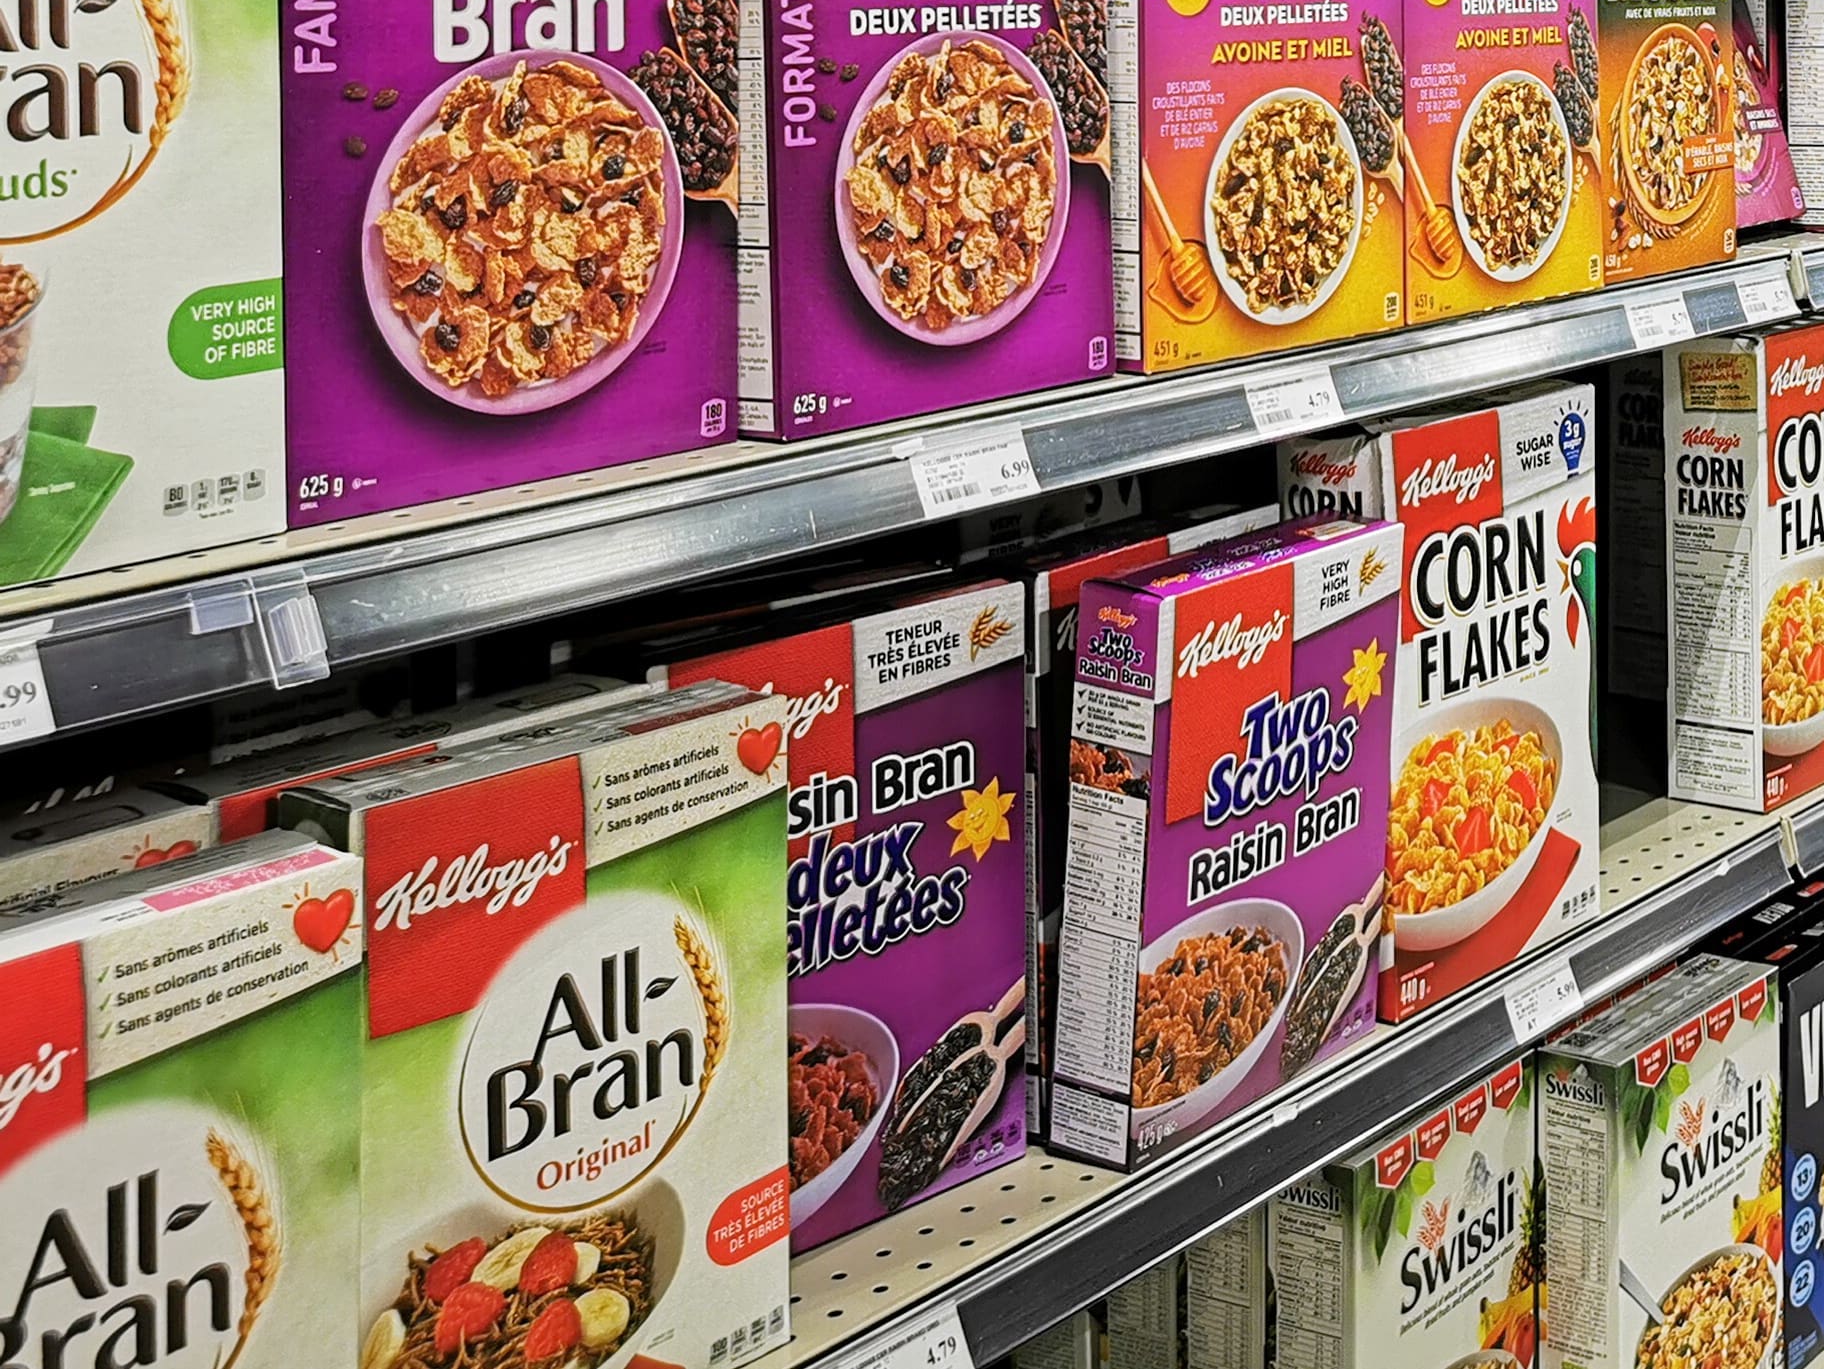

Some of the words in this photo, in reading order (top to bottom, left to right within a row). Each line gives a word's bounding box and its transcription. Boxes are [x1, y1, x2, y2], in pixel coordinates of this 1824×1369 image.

[848, 4, 917, 37] DEUX
[1211, 37, 1284, 64] AVOINE
[1287, 39, 1309, 60] ET
[1312, 36, 1353, 58] MIEL
[190, 301, 234, 323] VERY
[238, 296, 277, 317] HIGH
[211, 316, 277, 342] SOURCE
[204, 345, 228, 365] OF
[230, 336, 277, 361] FIBRE
[1307, 390, 1330, 406] 4.79
[1516, 433, 1554, 457] SUGAR
[1520, 448, 1553, 471] WISE
[299, 474, 330, 502] 625
[331, 478, 344, 499] g
[1402, 452, 1495, 509] Kellogg's
[1414, 510, 1546, 620] CORN
[1418, 598, 1551, 705] FLAKES
[1239, 685, 1329, 754] Two
[604, 773, 630, 787] Sans
[633, 759, 670, 780] arômes
[673, 745, 719, 767] artificiels
[1203, 719, 1357, 828] Scoops
[1187, 823, 1285, 905] Raisin
[1294, 787, 1359, 851] Bran
[374, 836, 573, 931] Kellogg's
[1557, 983, 1575, 1001] 5.99
[486, 1022, 696, 1164] Bran
[536, 1120, 652, 1193] Original
[1660, 1082, 1764, 1205] Swissli
